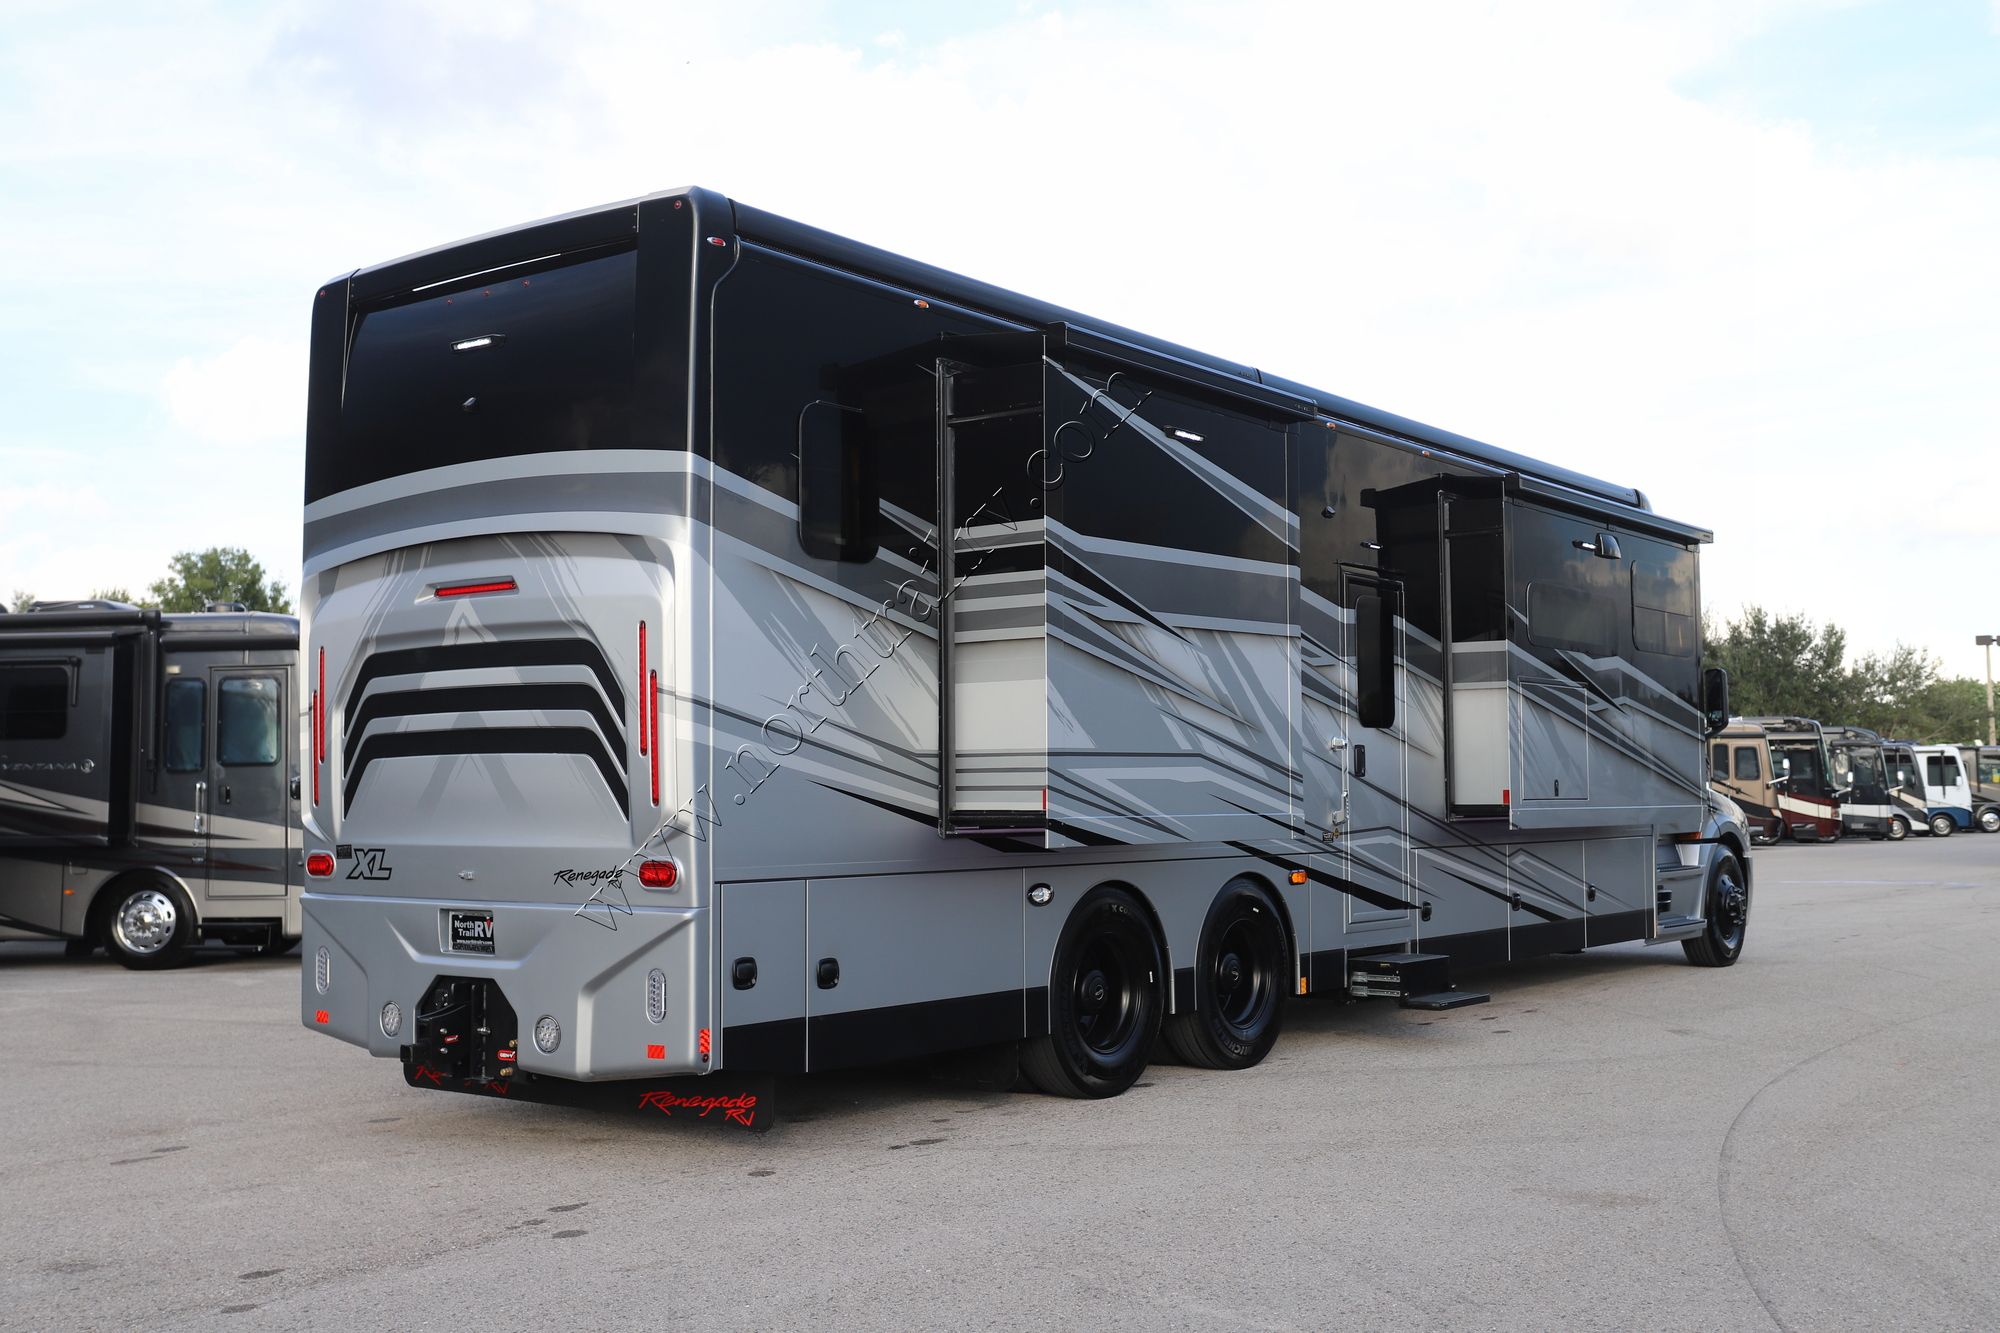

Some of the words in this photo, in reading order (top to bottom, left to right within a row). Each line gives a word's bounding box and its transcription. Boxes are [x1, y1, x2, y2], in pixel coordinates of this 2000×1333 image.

[345, 848, 393, 880] XL
[553, 865, 623, 889] Renegade
[454, 919, 474, 929] North
[458, 928, 474, 938] Trail
[474, 920, 493, 938] RV
[639, 1090, 757, 1117] Renegade
[724, 1107, 756, 1127] RV
